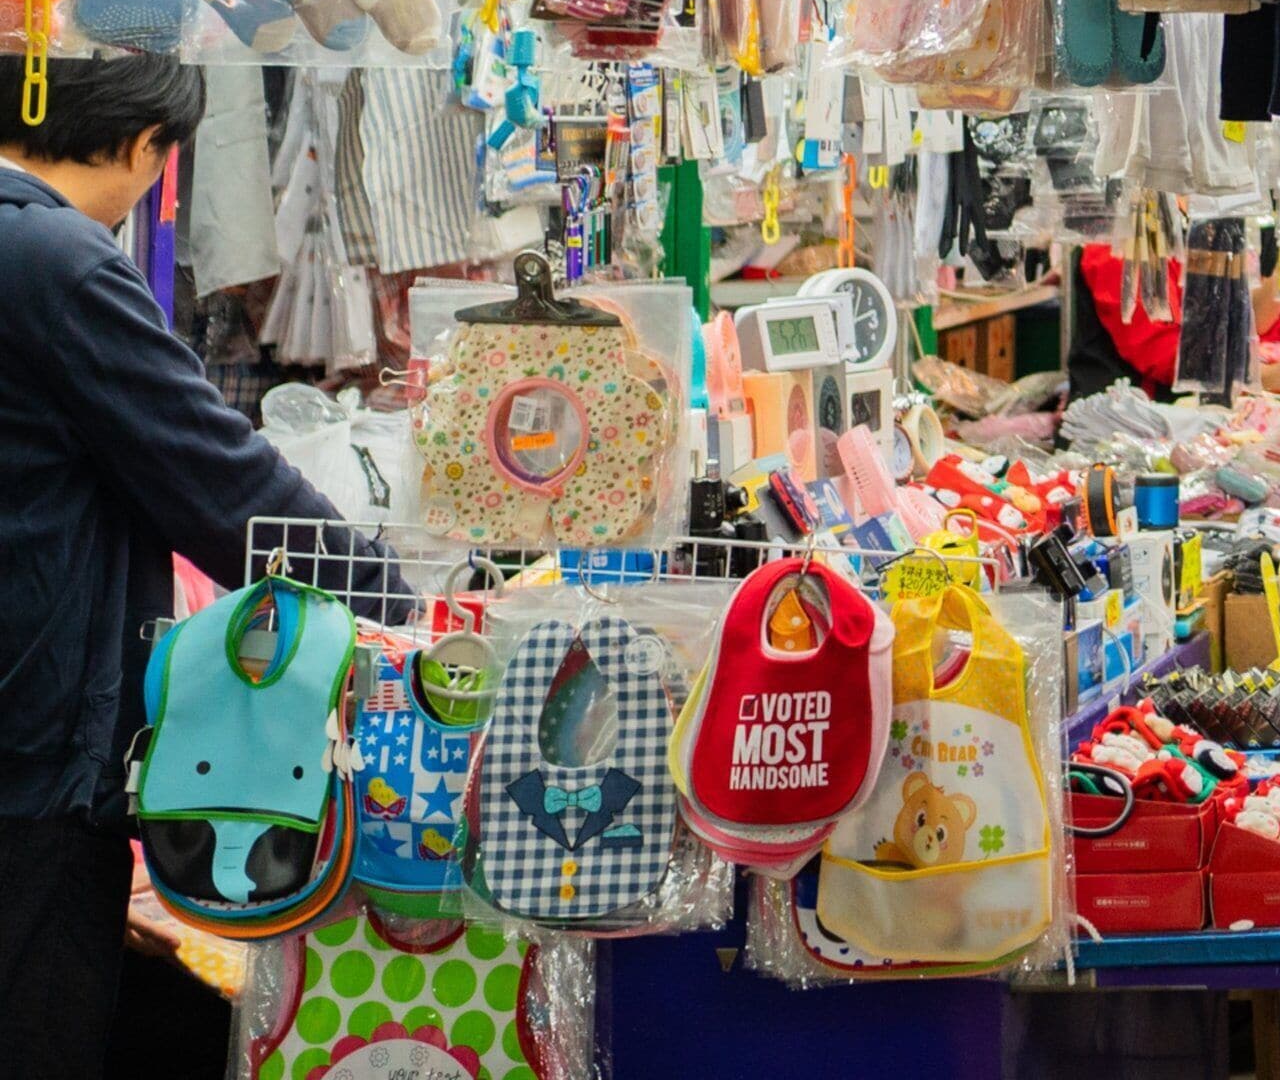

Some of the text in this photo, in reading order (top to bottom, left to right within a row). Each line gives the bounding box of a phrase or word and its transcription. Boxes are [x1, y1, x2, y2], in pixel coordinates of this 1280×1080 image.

[761, 690, 832, 722] VOTED
[731, 721, 830, 766] MOST
[728, 762, 829, 790] HANDSOME
